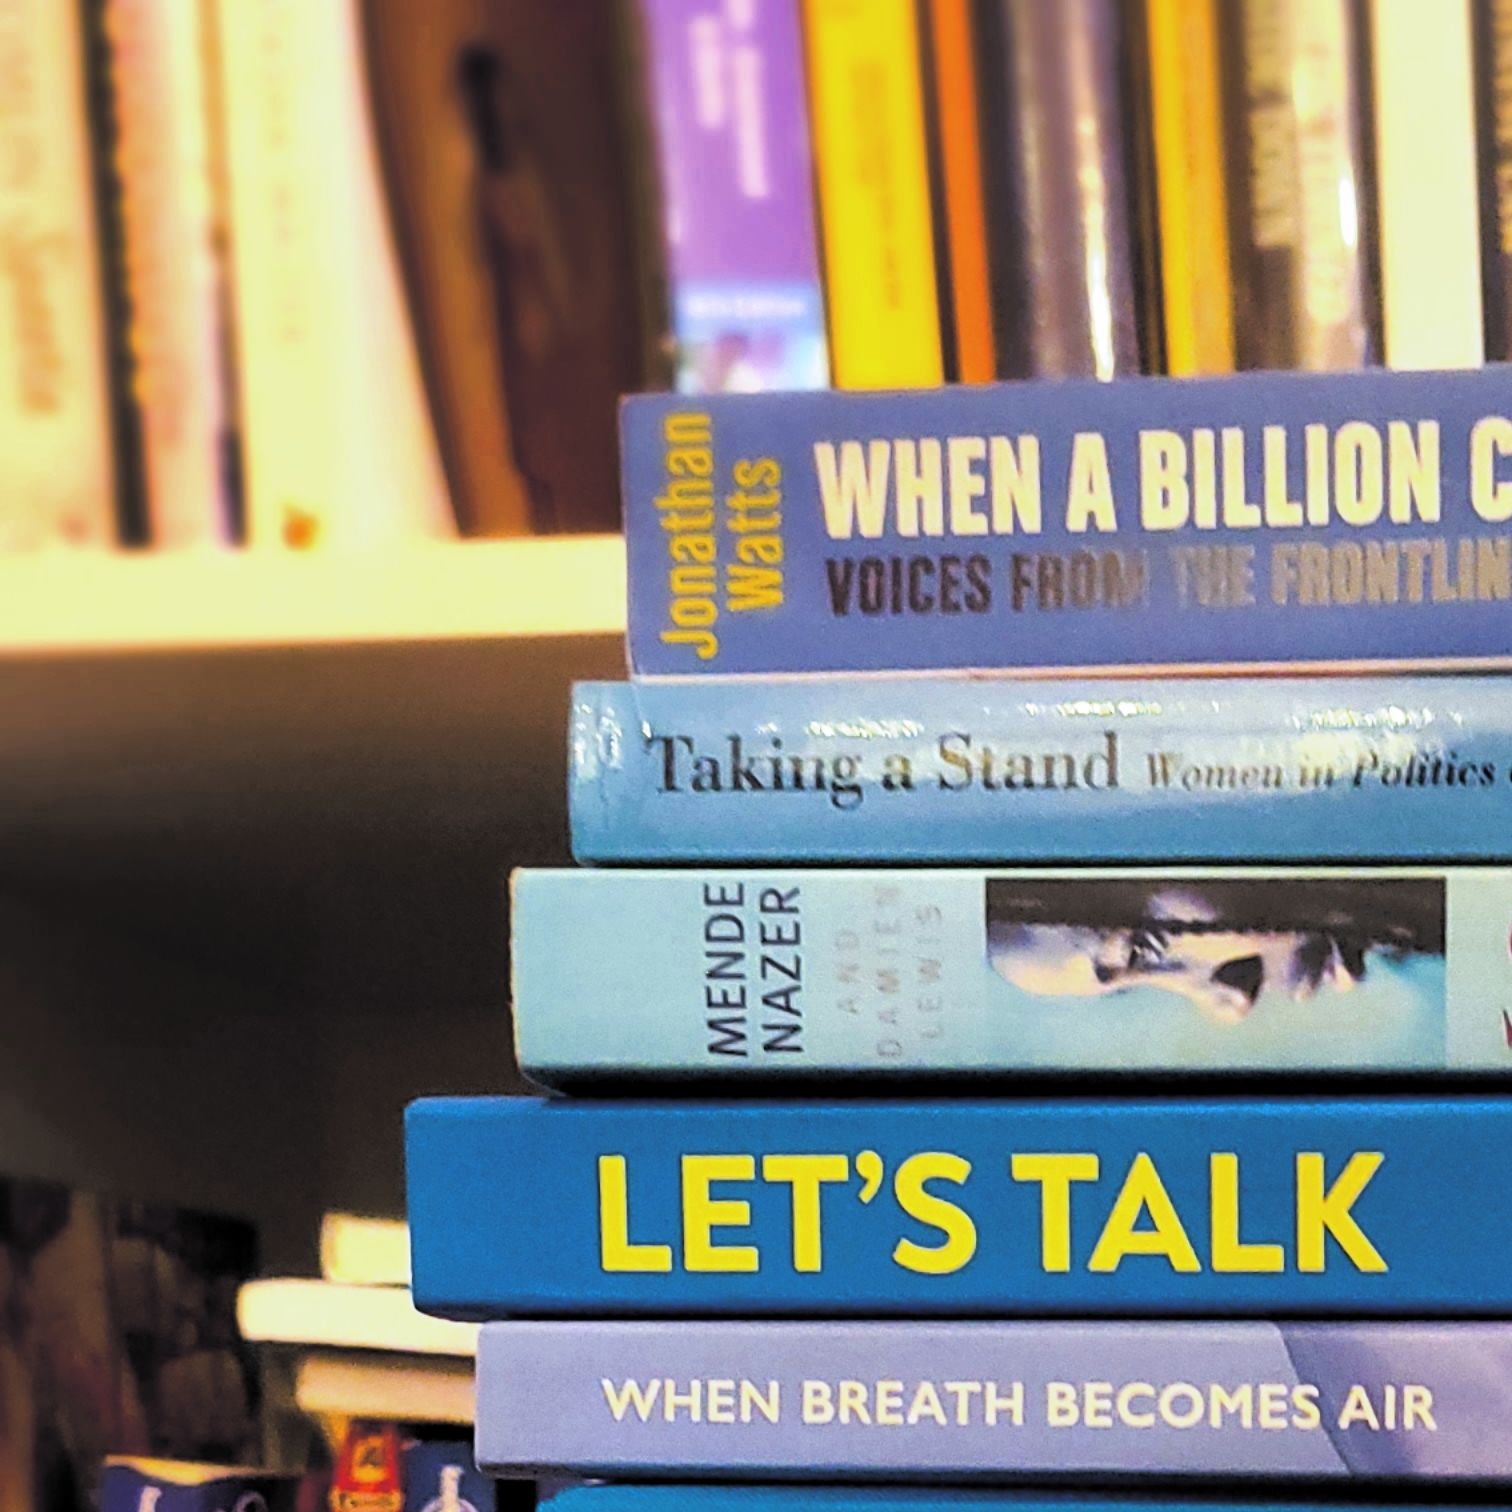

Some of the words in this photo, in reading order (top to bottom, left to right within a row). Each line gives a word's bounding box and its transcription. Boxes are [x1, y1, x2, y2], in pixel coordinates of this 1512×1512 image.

[655, 411, 718, 658] Jonathan
[727, 457, 785, 611] Watts
[814, 434, 1042, 540] WHEN
[1066, 432, 1119, 533] A
[1139, 421, 1440, 531] BILLION
[825, 552, 992, 616] VOICES
[1011, 547, 1150, 614] FROM
[1172, 543, 1256, 607] THE
[647, 733, 863, 808] Taking
[882, 751, 915, 792] a
[937, 731, 1120, 792] Stand
[1147, 749, 1283, 790] Women
[1352, 745, 1496, 788] Politics
[704, 881, 748, 1058] MENDE
[761, 886, 804, 1054] NAZER
[836, 929, 860, 1015] AND
[916, 905, 943, 1039] LEWIS
[599, 1149, 977, 1274] LET’S
[1010, 1151, 1389, 1273] TALK
[602, 1377, 781, 1426] WHEN
[801, 1378, 1025, 1427] BREATH
[1046, 1381, 1321, 1430] BECOMES
[1339, 1383, 1438, 1432] AIR
